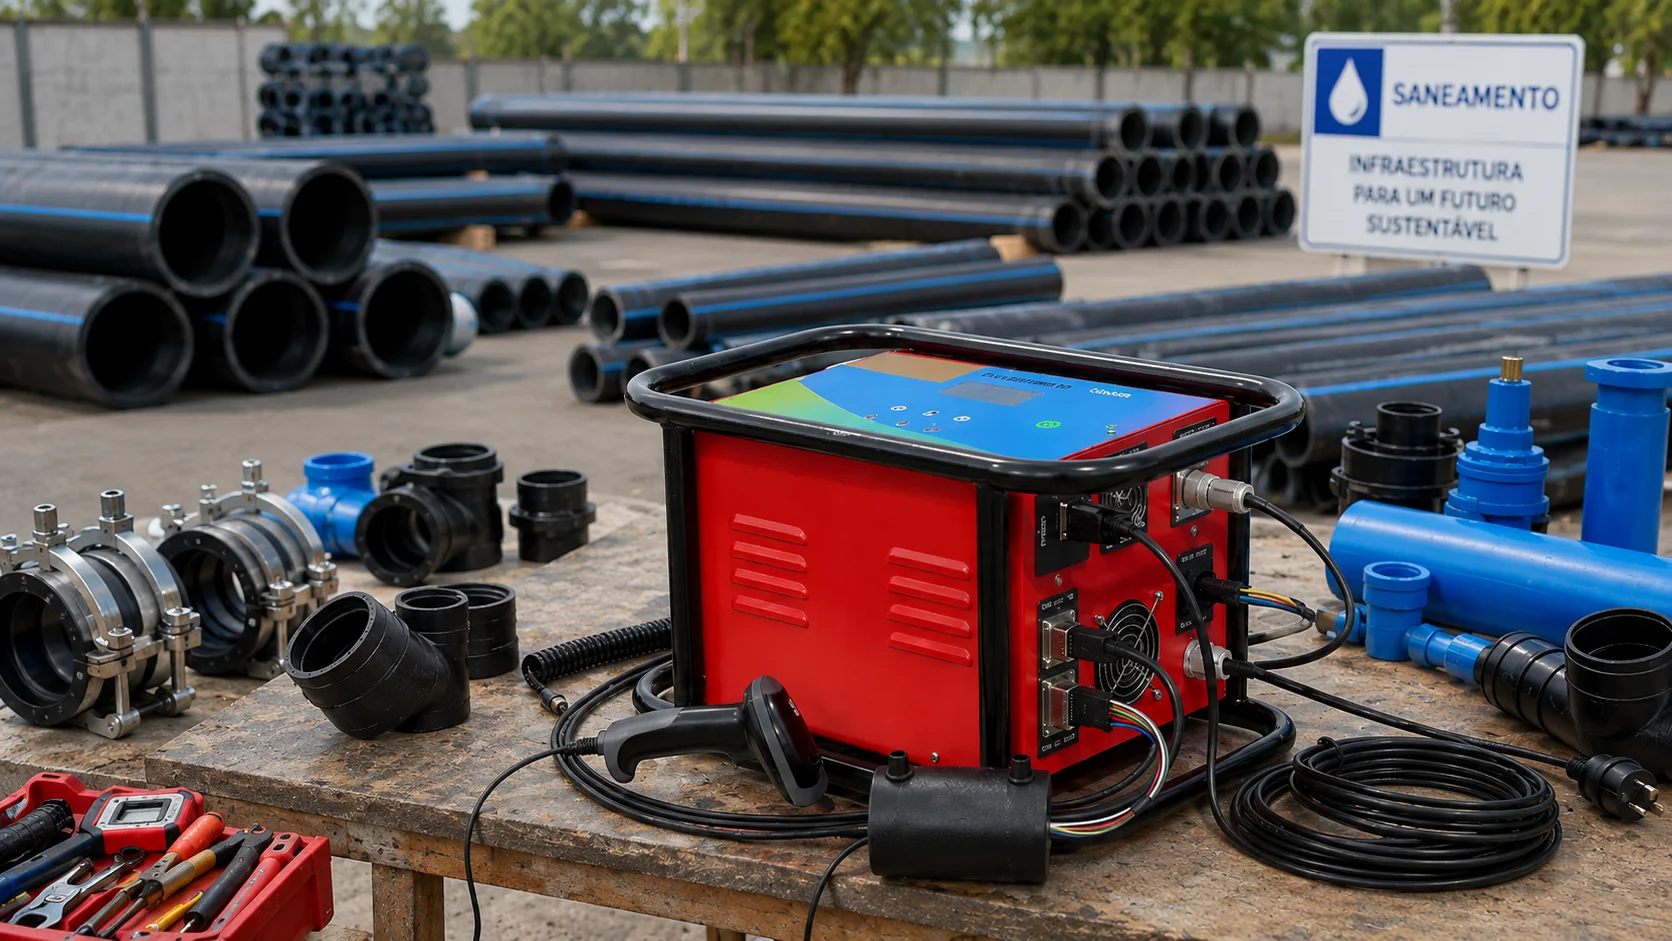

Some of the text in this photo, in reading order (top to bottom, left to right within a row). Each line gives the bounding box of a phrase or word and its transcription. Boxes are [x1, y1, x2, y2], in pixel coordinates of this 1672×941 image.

[1392, 82, 1560, 110] SANEAMENTO
[1349, 153, 1524, 181] INFRAESTRUTURA
[1353, 184, 1517, 213] PARA UM FUTURO
[1366, 214, 1498, 241] SUSTENTÁVEL
